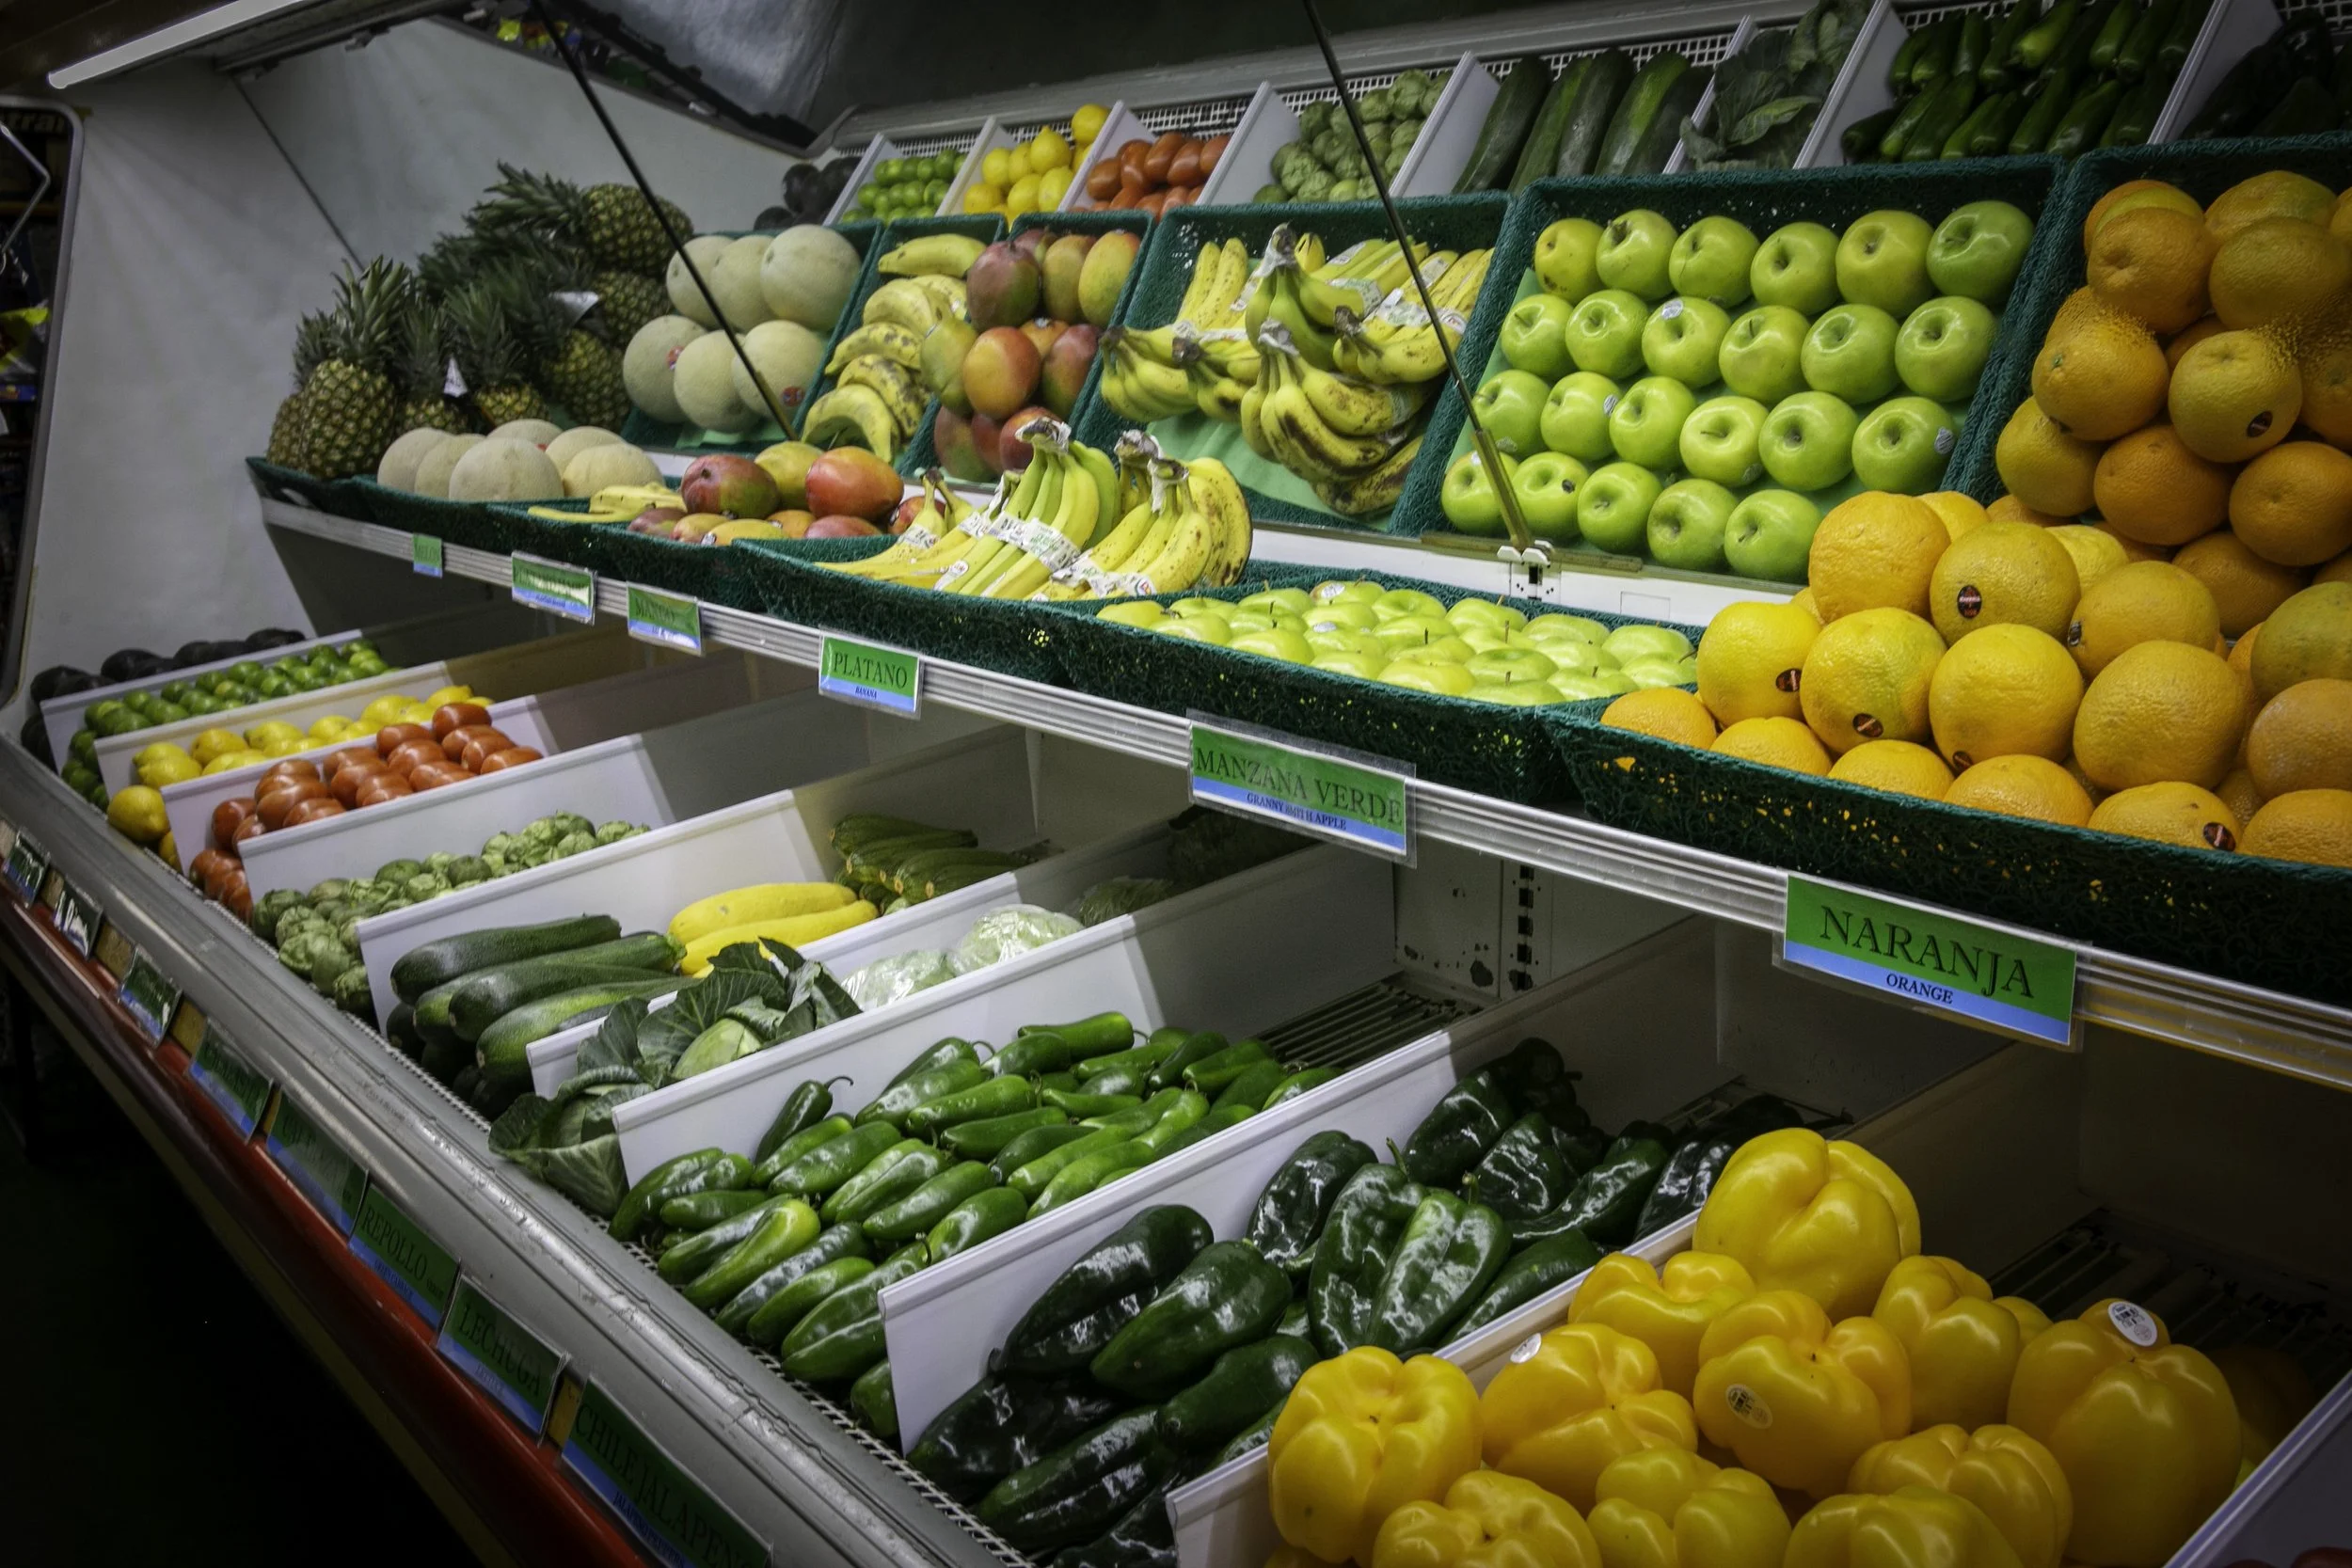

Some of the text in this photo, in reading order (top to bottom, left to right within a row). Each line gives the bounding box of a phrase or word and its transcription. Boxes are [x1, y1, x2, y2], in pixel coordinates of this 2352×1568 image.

[834, 652, 908, 689] PLATANO
[854, 686, 878, 700] BANANA
[1195, 748, 1404, 827] MANZANA VERDE
[1247, 792, 1284, 812] GRANNY
[1314, 812, 1347, 831] APPLE
[1820, 905, 2035, 999] NARANJA
[1885, 973, 1954, 1005] ORANGE
[361, 1204, 427, 1281] REPOLLO
[458, 1303, 541, 1397] LECHUGA
[575, 1402, 755, 1568] CHILE JALAPEN
